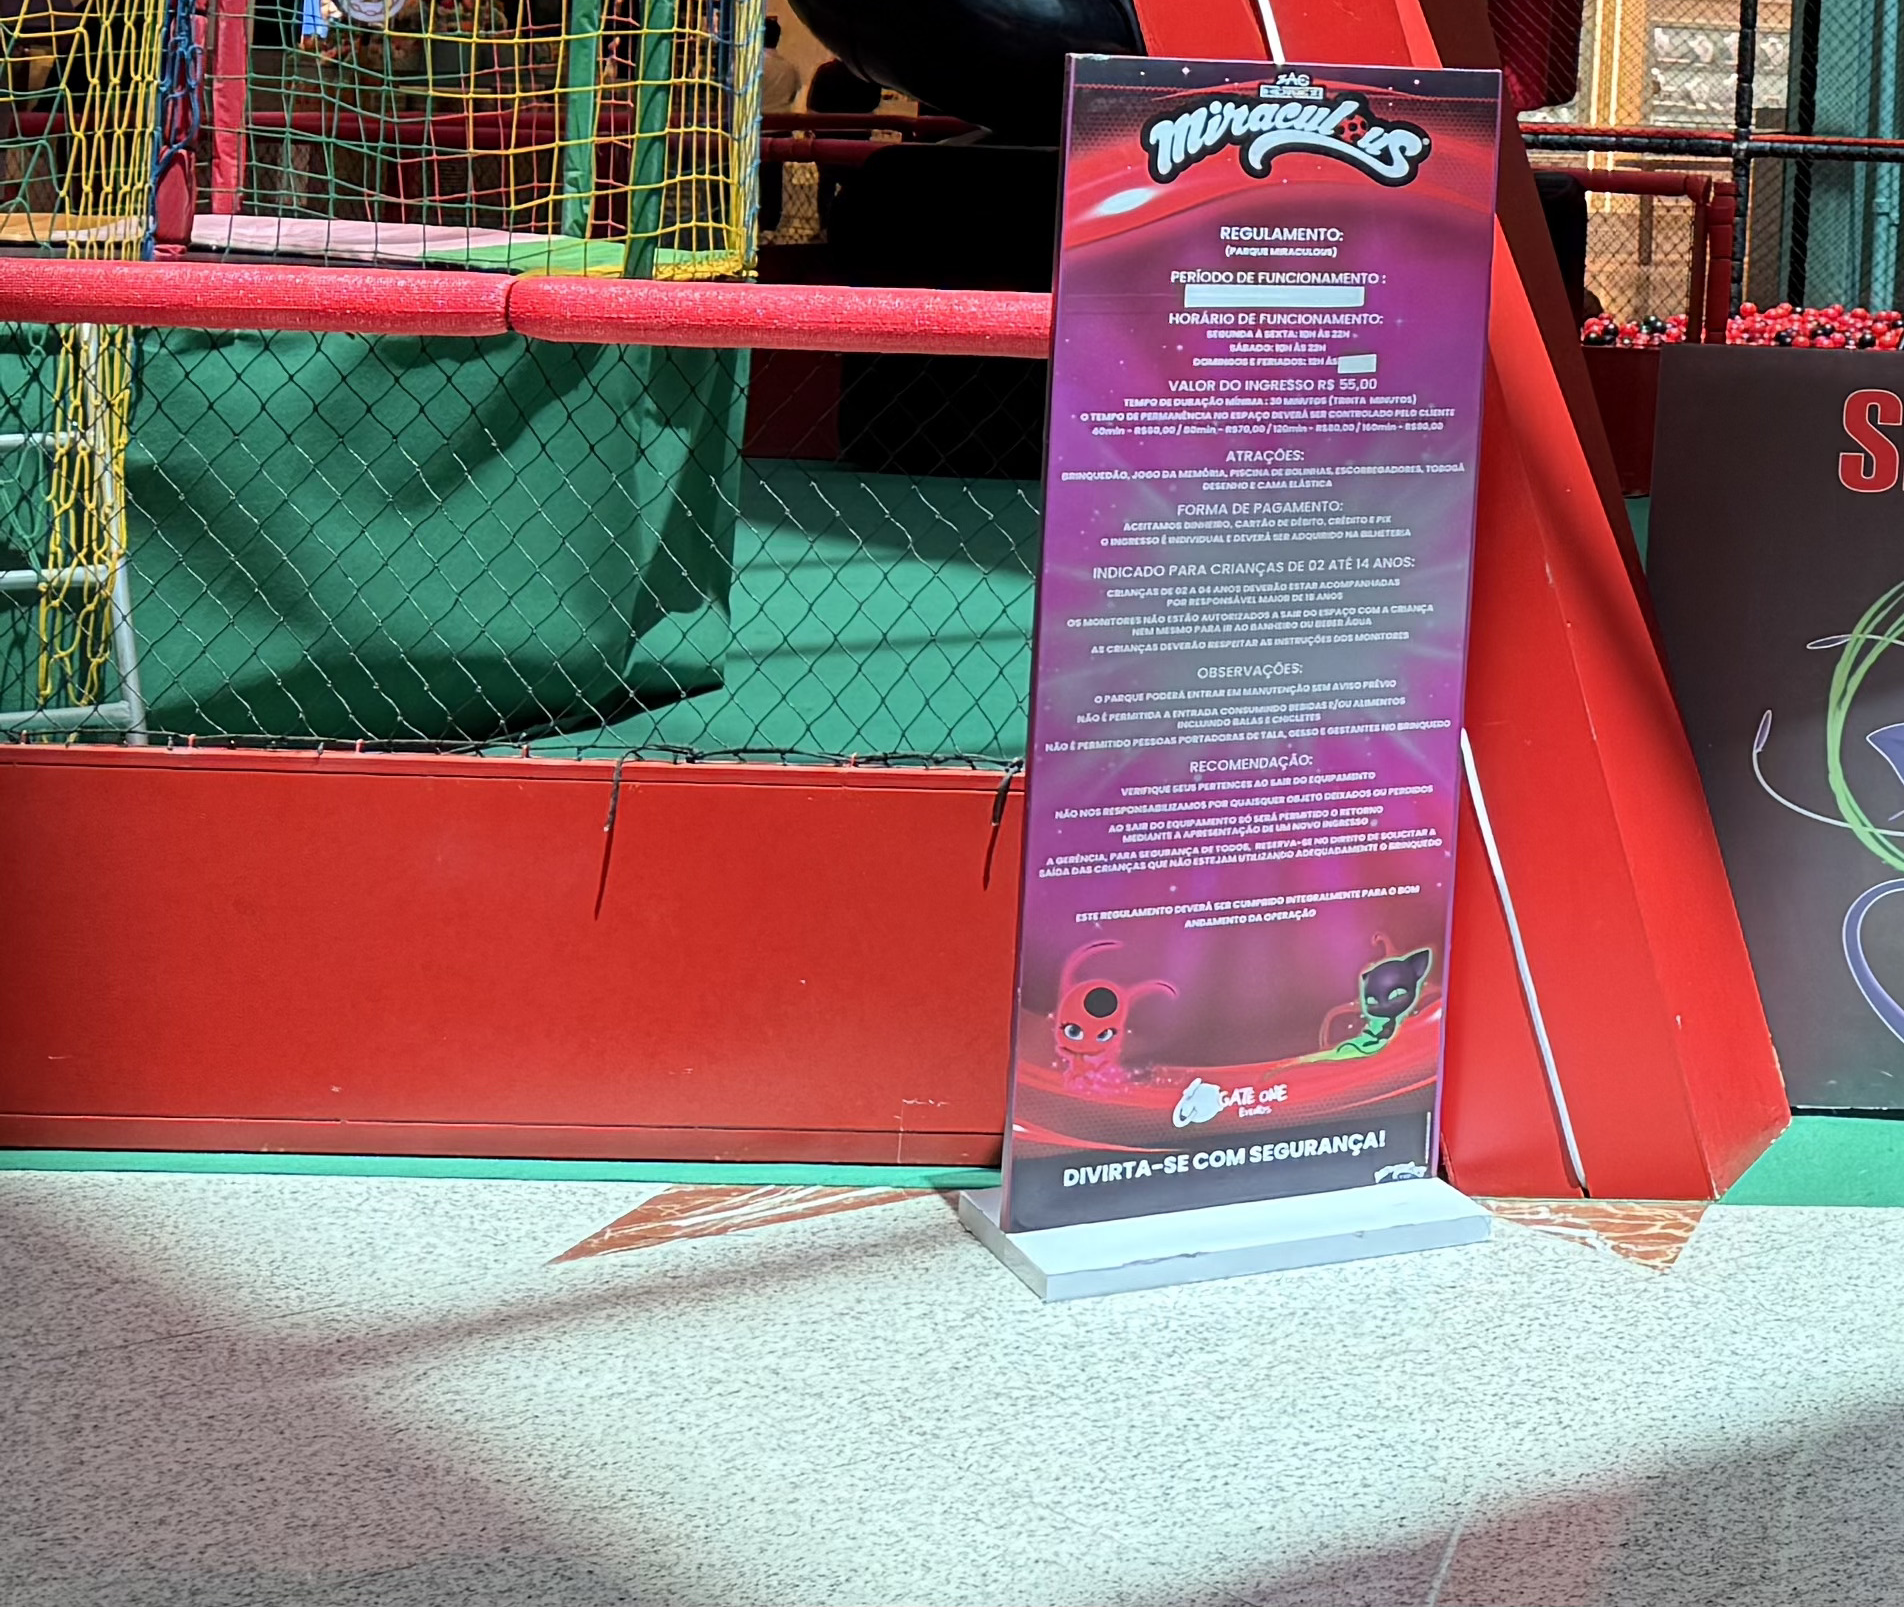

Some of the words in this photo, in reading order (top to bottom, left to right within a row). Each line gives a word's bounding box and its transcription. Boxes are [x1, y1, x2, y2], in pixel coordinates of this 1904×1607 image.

[1220, 227, 1344, 242] REGULAMENTO:
[1170, 268, 1233, 283] PERÍODO
[1236, 272, 1254, 283] DE
[1168, 310, 1234, 325] HORÁRIO
[1238, 314, 1255, 325] DE
[1259, 314, 1384, 325] FUNCIONAMENTO:
[1168, 380, 1215, 391] VALOR
[1219, 380, 1241, 391] DO
[1244, 379, 1314, 391] INGRESSO
[1339, 379, 1378, 392] 55,00
[1226, 448, 1304, 463] ATRAÇÕES:
[1177, 504, 1227, 516] FORMA
[1231, 503, 1249, 514] DE
[1253, 501, 1343, 514] PAGAMENTO:
[1093, 565, 1165, 579] INDICADO
[1168, 564, 1206, 576] PARA
[1210, 561, 1283, 575] CRIANÇAS
[1287, 560, 1304, 572] DE
[1308, 560, 1324, 571] 02
[1328, 556, 1352, 570] ATÉ
[1356, 558, 1368, 569] 14
[1372, 557, 1415, 569] ANOS:
[1197, 662, 1303, 678] OBSERVAÇÕES:
[1190, 753, 1313, 773] RECOMENDAÇÃO:
[1063, 1154, 1189, 1186] DIVIRTA-SE
[1192, 1148, 1245, 1171] COM
[1249, 1130, 1386, 1164] SEGURANÇA!
